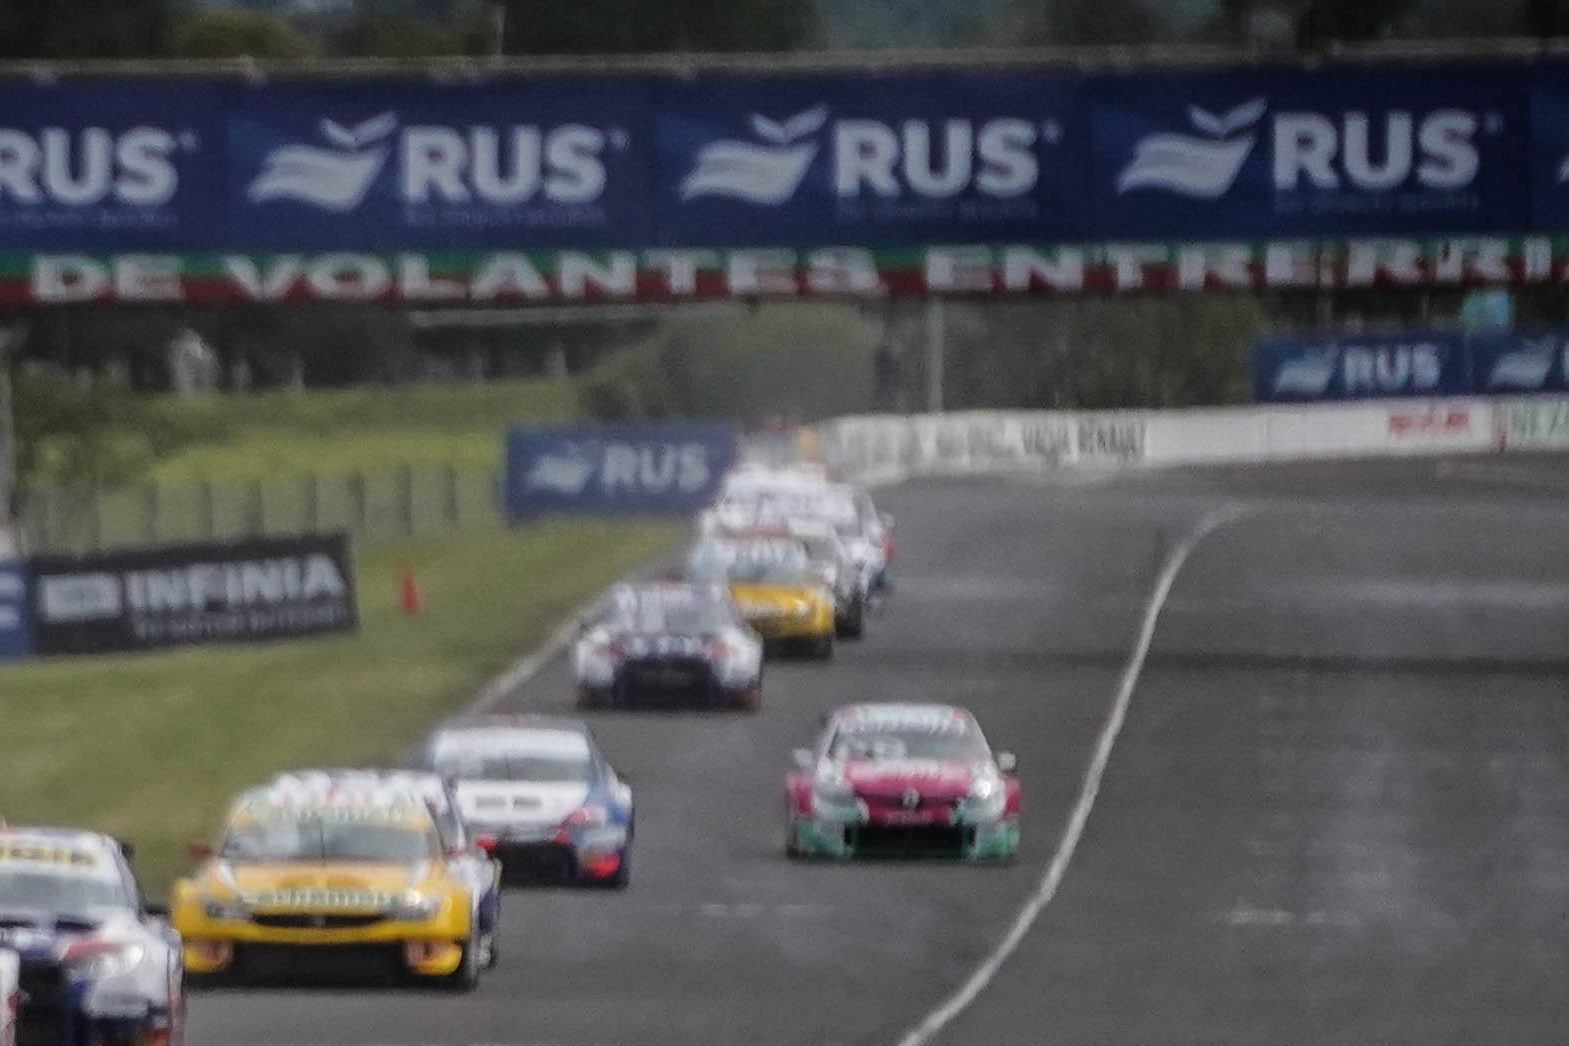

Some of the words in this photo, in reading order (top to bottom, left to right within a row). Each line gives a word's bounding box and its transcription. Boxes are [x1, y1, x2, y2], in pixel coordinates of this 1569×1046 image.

[400, 124, 608, 204] RUS
[834, 117, 1039, 198] RUS
[1274, 110, 1479, 190] RUS
[33, 254, 186, 301] DE
[222, 247, 888, 301] VOLANTES
[925, 237, 1569, 292] ENTRERRI
[602, 442, 711, 494] RUS
[127, 553, 345, 611] INFINIA
